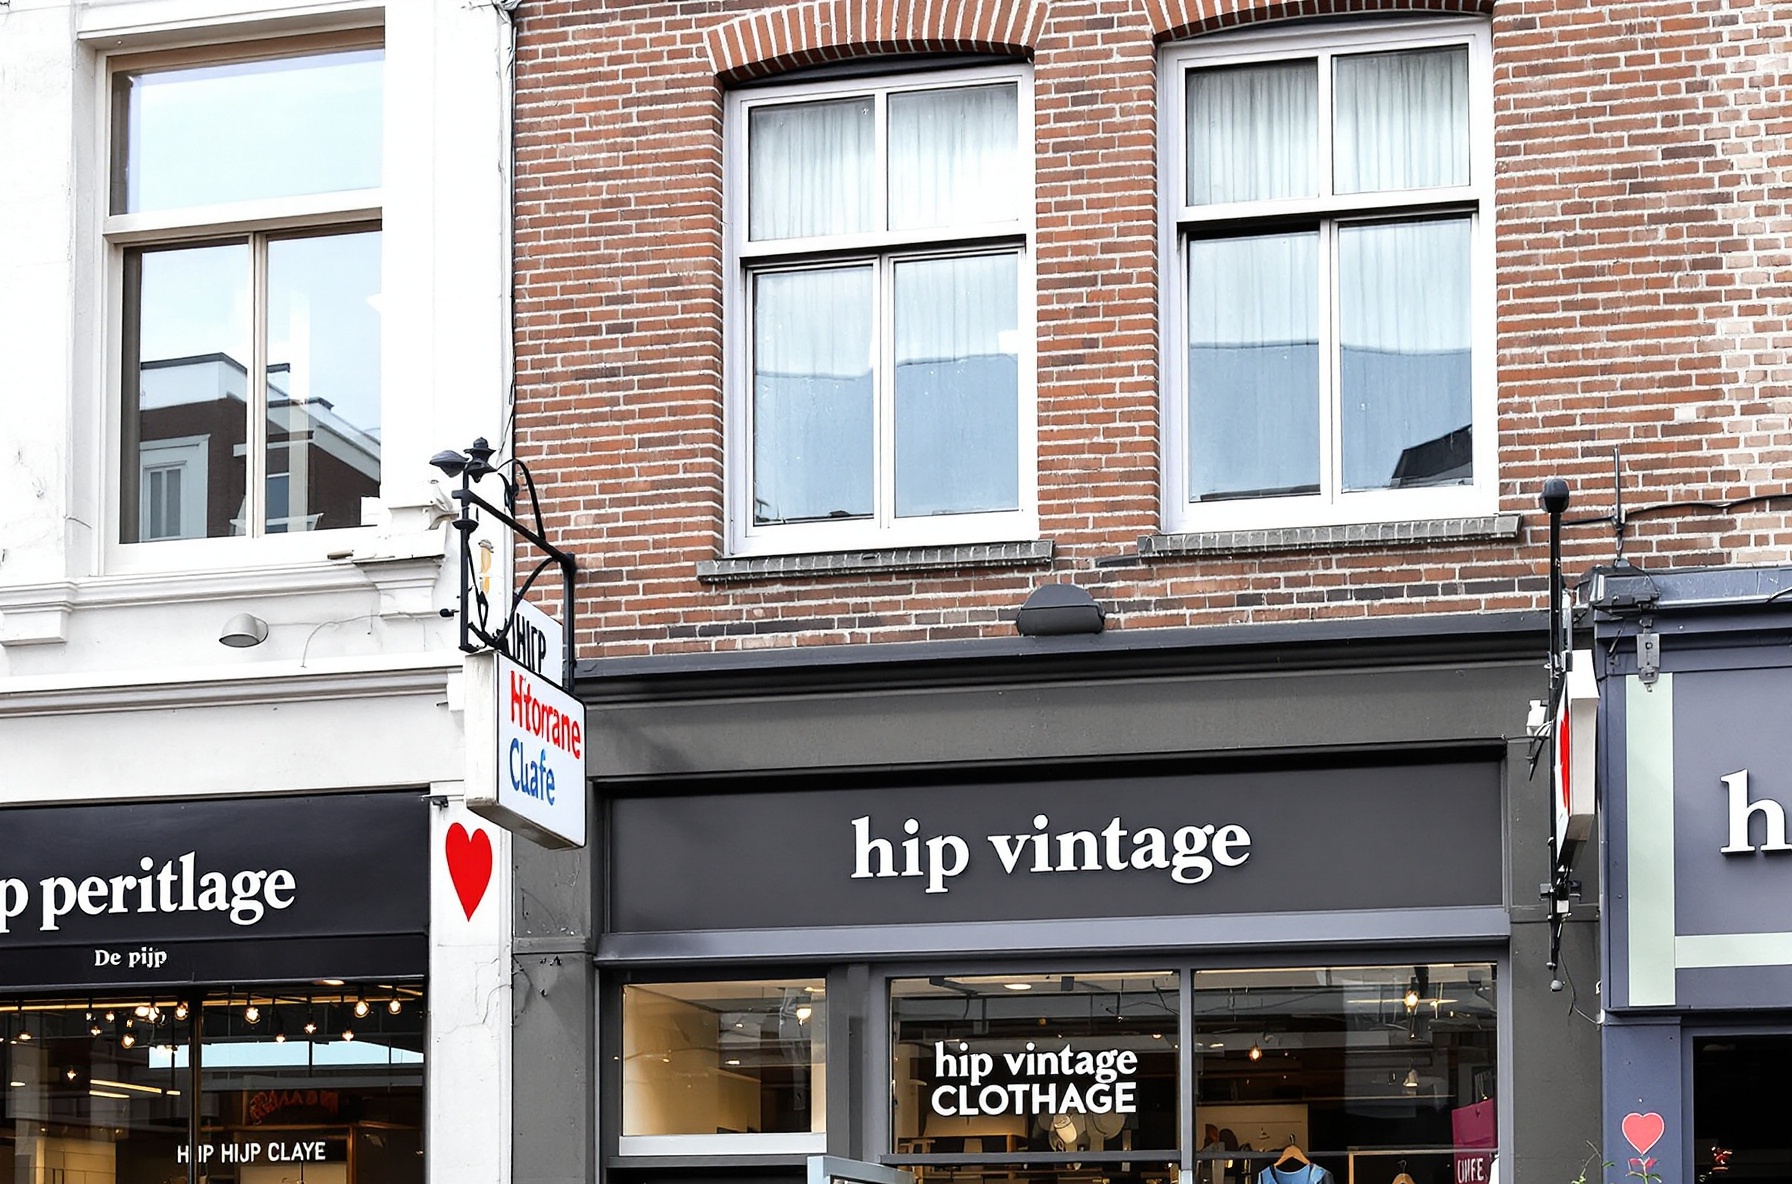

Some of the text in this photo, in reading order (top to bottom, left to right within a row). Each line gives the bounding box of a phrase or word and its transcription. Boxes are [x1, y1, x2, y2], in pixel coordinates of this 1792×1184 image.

[850, 814, 1253, 893] hip vintage
[39, 850, 297, 932] peritlage
[94, 947, 168, 968] De pijp
[935, 1041, 1138, 1086] hip vintage
[931, 1082, 1137, 1116] CLOTHAGE
[267, 1141, 326, 1161] CLAYE
